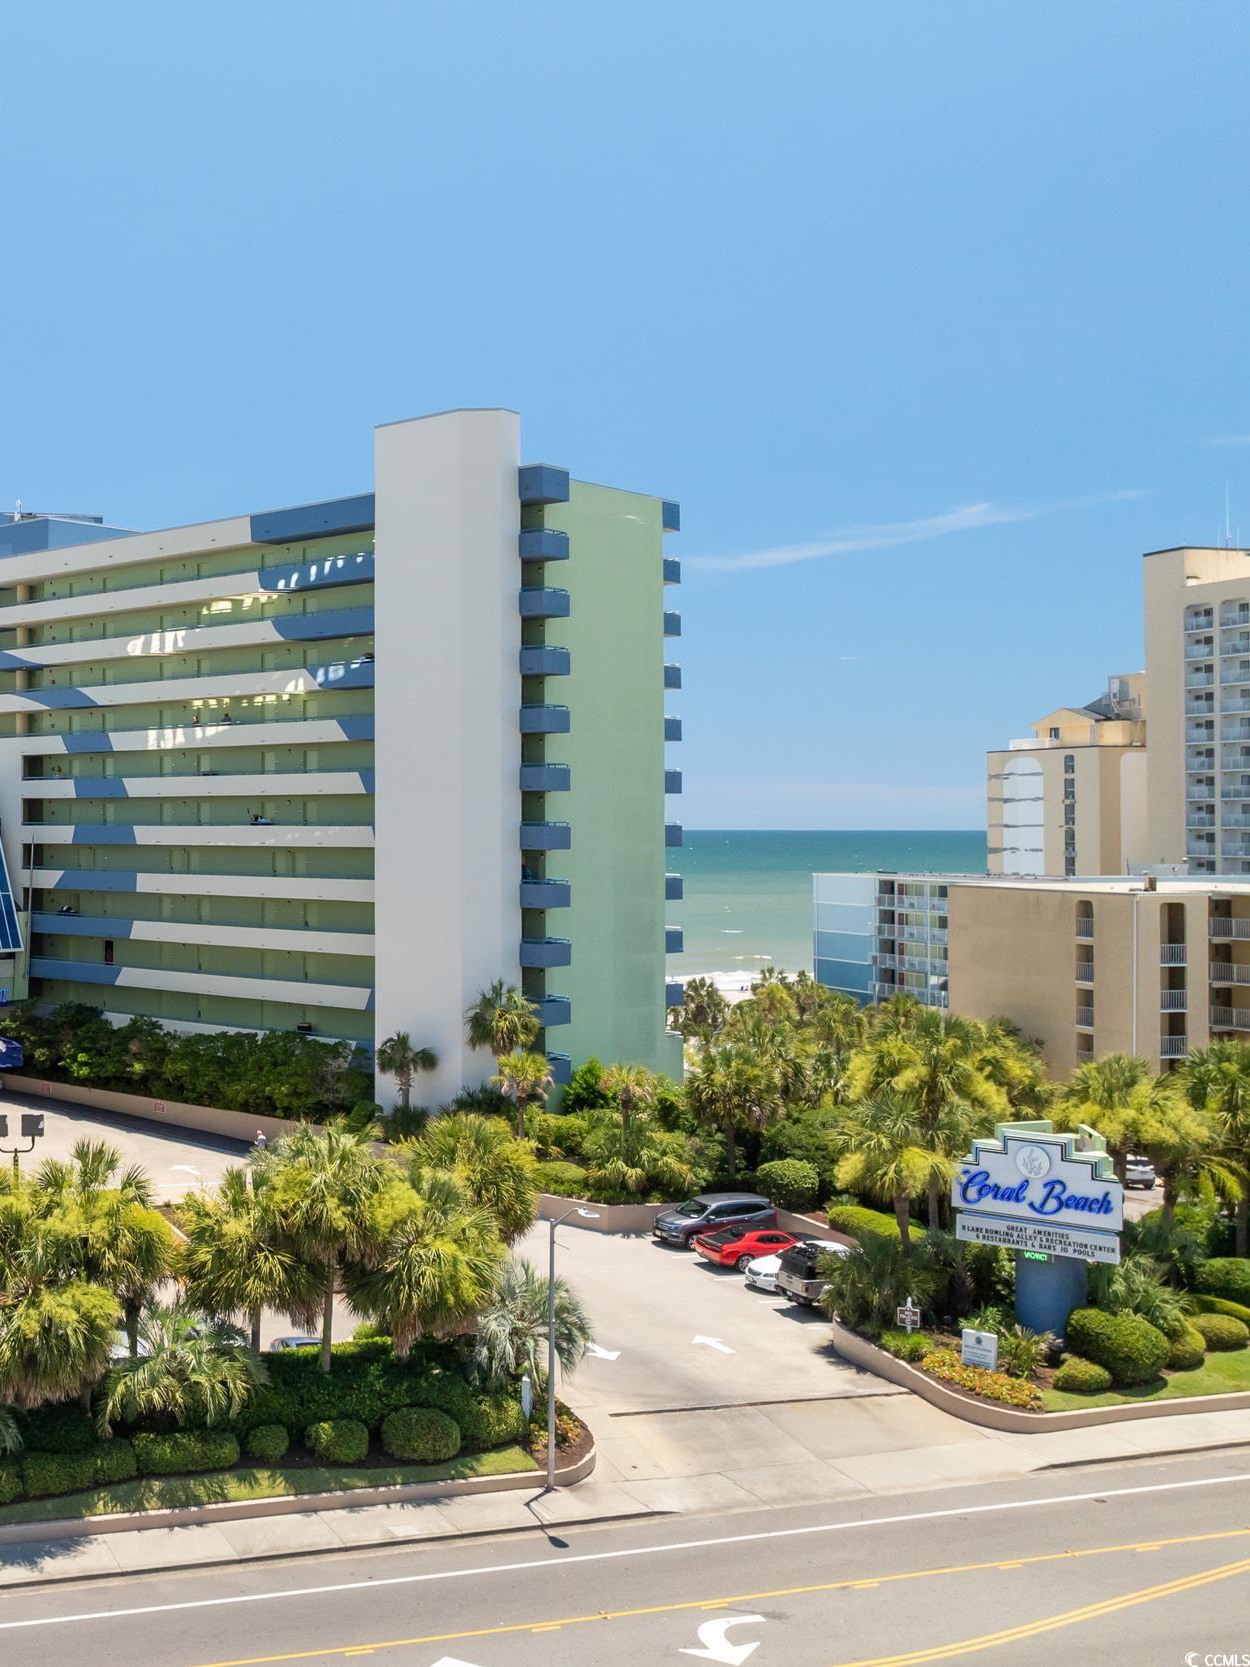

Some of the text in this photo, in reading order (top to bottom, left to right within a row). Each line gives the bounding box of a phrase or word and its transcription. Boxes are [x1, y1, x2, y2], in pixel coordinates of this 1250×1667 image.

[956, 1168, 1114, 1215] Coral Beach
[967, 1225, 983, 1234] LANE
[985, 1228, 1014, 1238] BOWLING
[1016, 1232, 1038, 1242] ALLEY
[1045, 1237, 1089, 1250] RECREATION
[1090, 1244, 1116, 1254] CENTER
[1006, 1224, 1070, 1240] GREAT AMENITIES
[982, 1234, 1028, 1247] RESTAURANTS
[1038, 1242, 1056, 1252] BARS
[1072, 1248, 1096, 1258] POOLS
[1023, 1250, 1048, 1261] VACANCY
